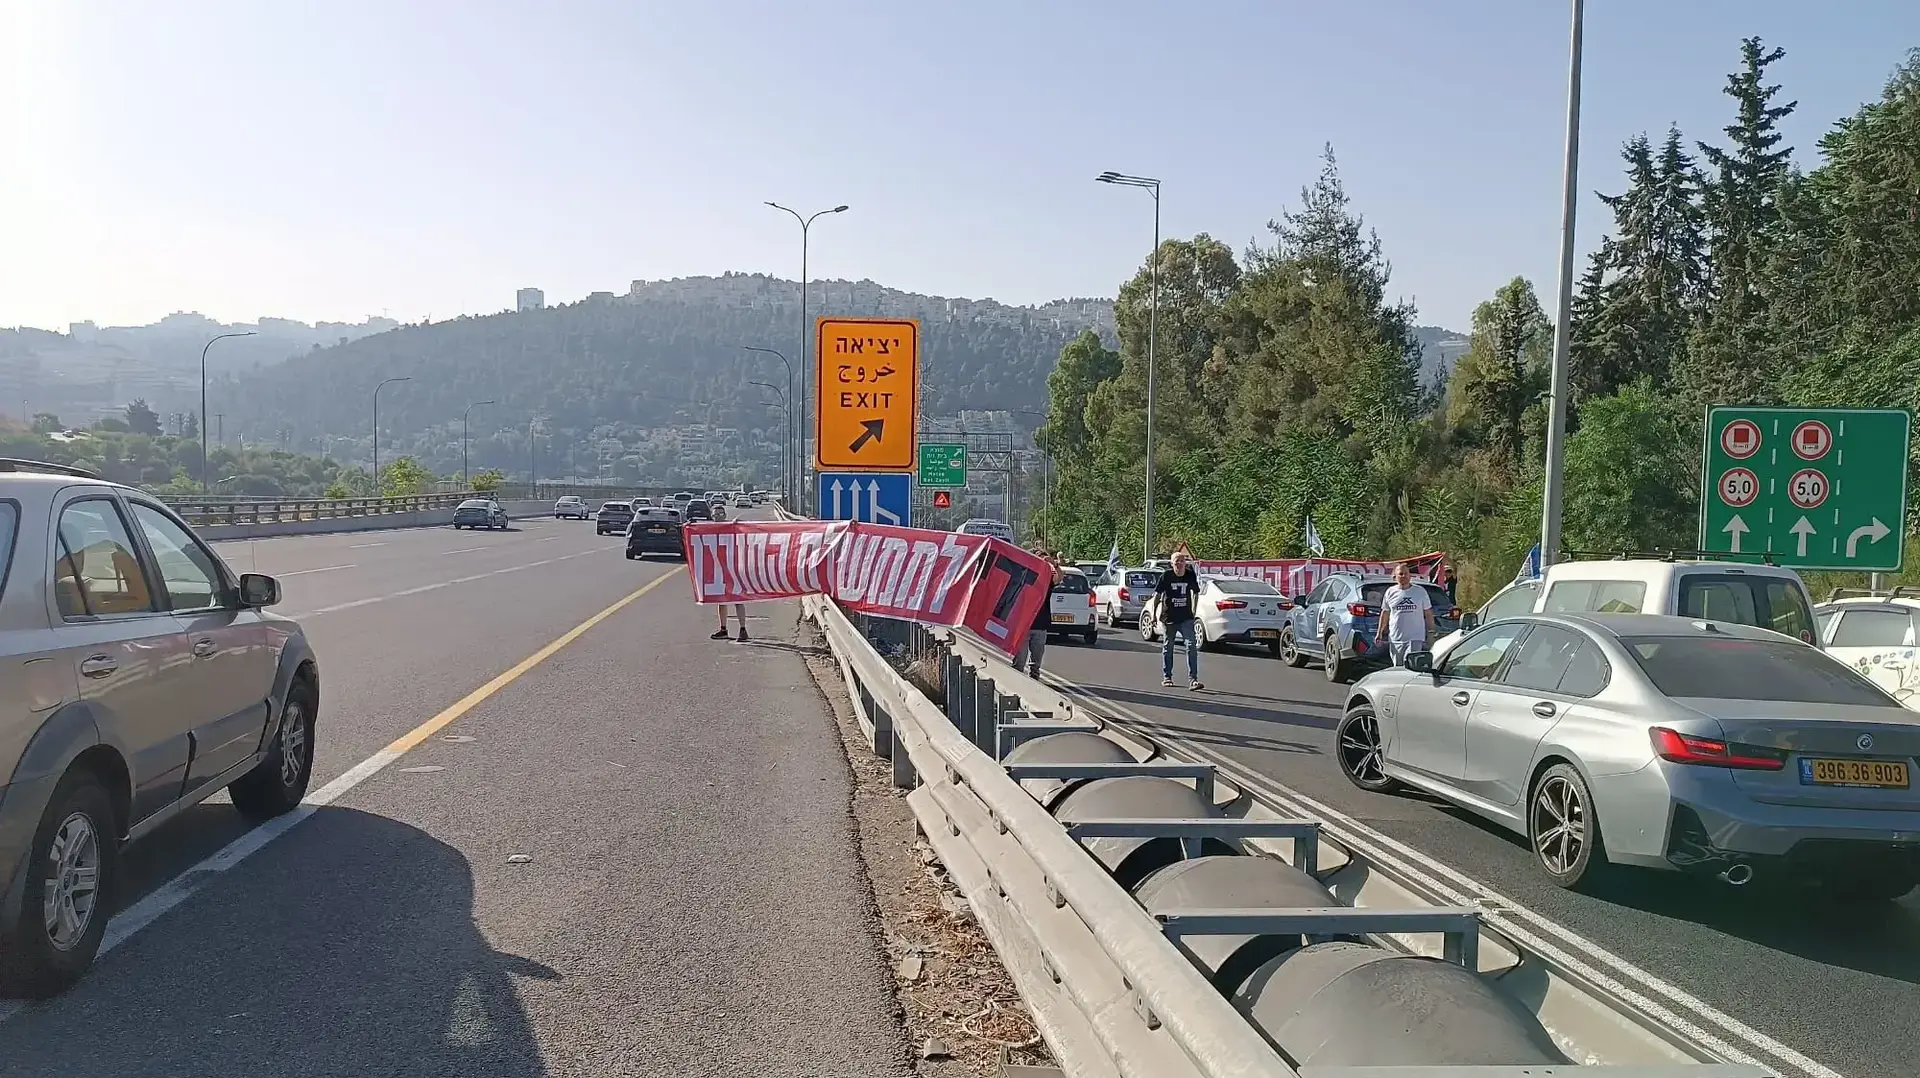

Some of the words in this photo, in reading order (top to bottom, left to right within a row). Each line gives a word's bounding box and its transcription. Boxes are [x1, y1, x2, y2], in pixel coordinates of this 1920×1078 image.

[835, 337, 900, 354] יציאה
[837, 362, 896, 383] خروج
[840, 392, 893, 409] EXIT
[1727, 480, 1751, 494] 5.0
[1797, 482, 1820, 496] 5.0
[690, 533, 797, 600] החורבן
